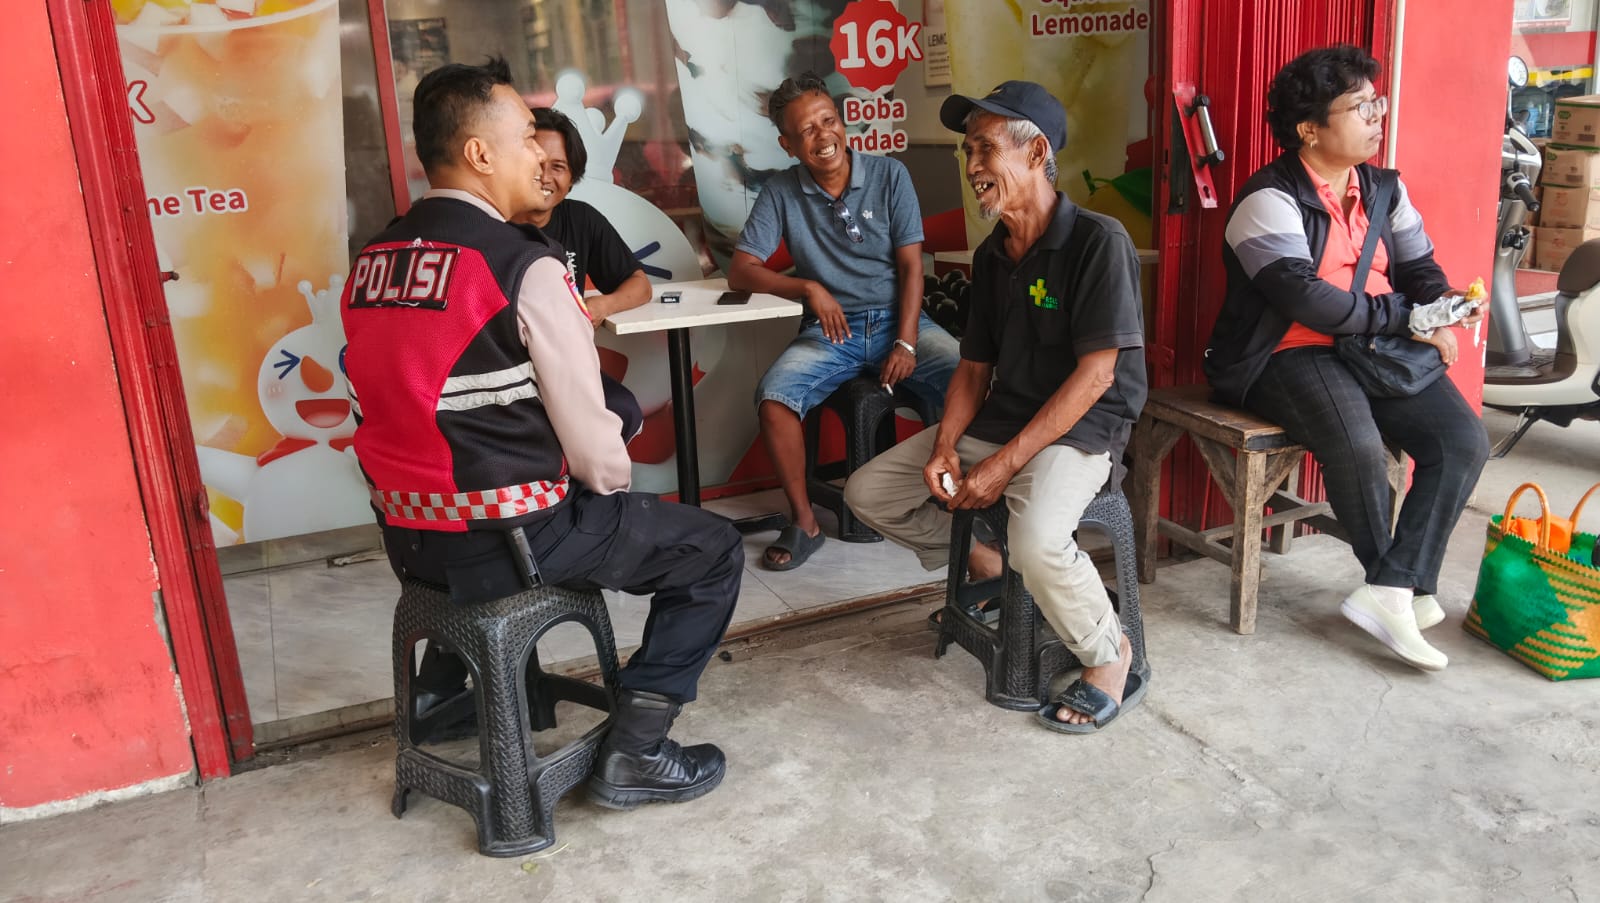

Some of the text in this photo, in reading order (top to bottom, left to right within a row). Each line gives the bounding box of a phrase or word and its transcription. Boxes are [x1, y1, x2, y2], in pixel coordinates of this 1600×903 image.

[1032, 8, 1148, 35] Lemonade
[840, 19, 923, 69] 16K
[847, 97, 905, 122] Boba
[187, 188, 245, 213] Tea
[349, 250, 454, 305] POLISI
